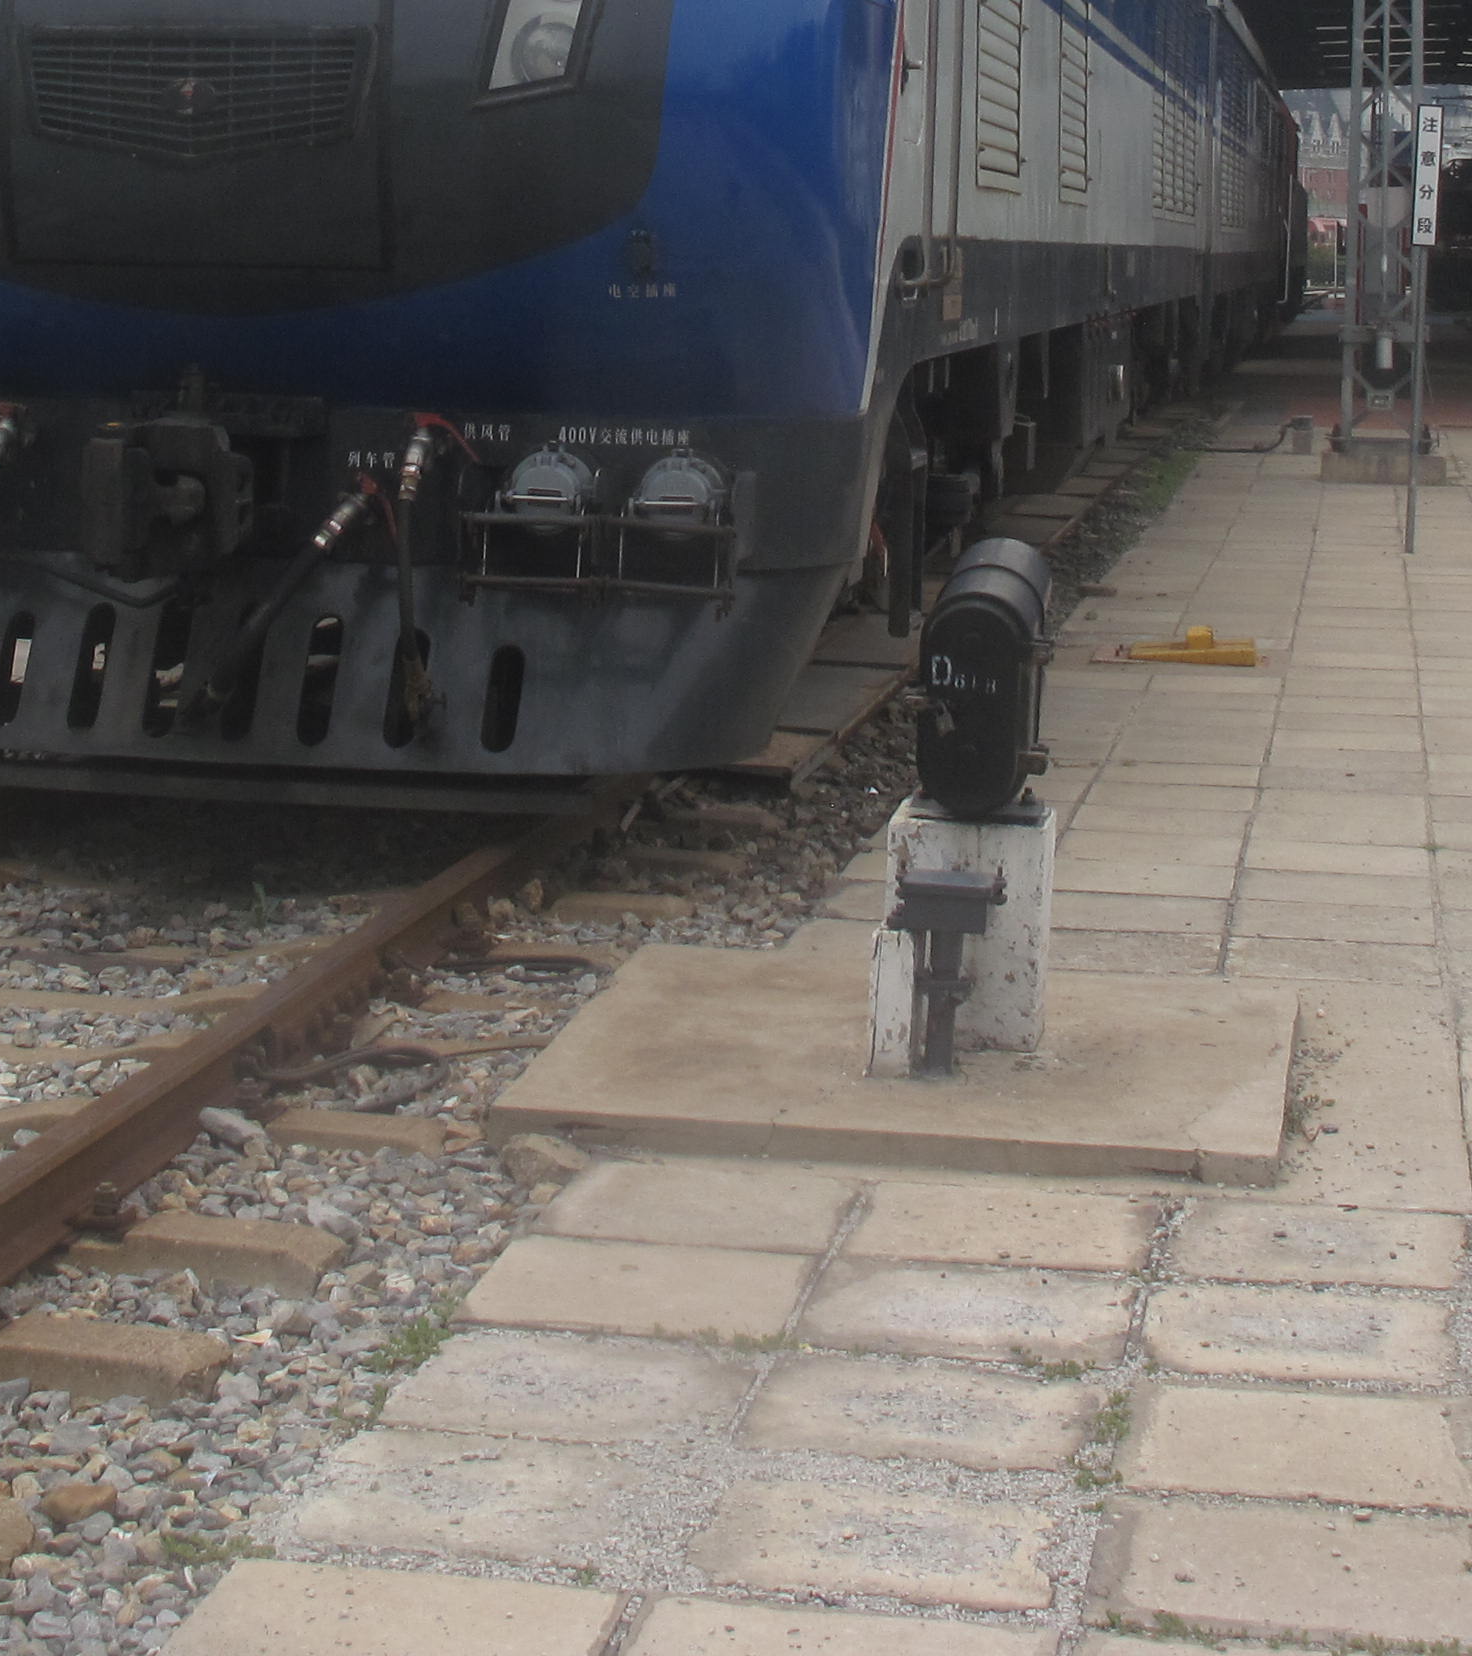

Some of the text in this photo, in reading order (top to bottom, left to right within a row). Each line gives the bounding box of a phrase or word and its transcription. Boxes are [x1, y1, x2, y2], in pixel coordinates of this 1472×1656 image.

[1417, 117, 1438, 234] 注意分段
[463, 422, 512, 442] 供风管
[347, 450, 397, 469] 列车管
